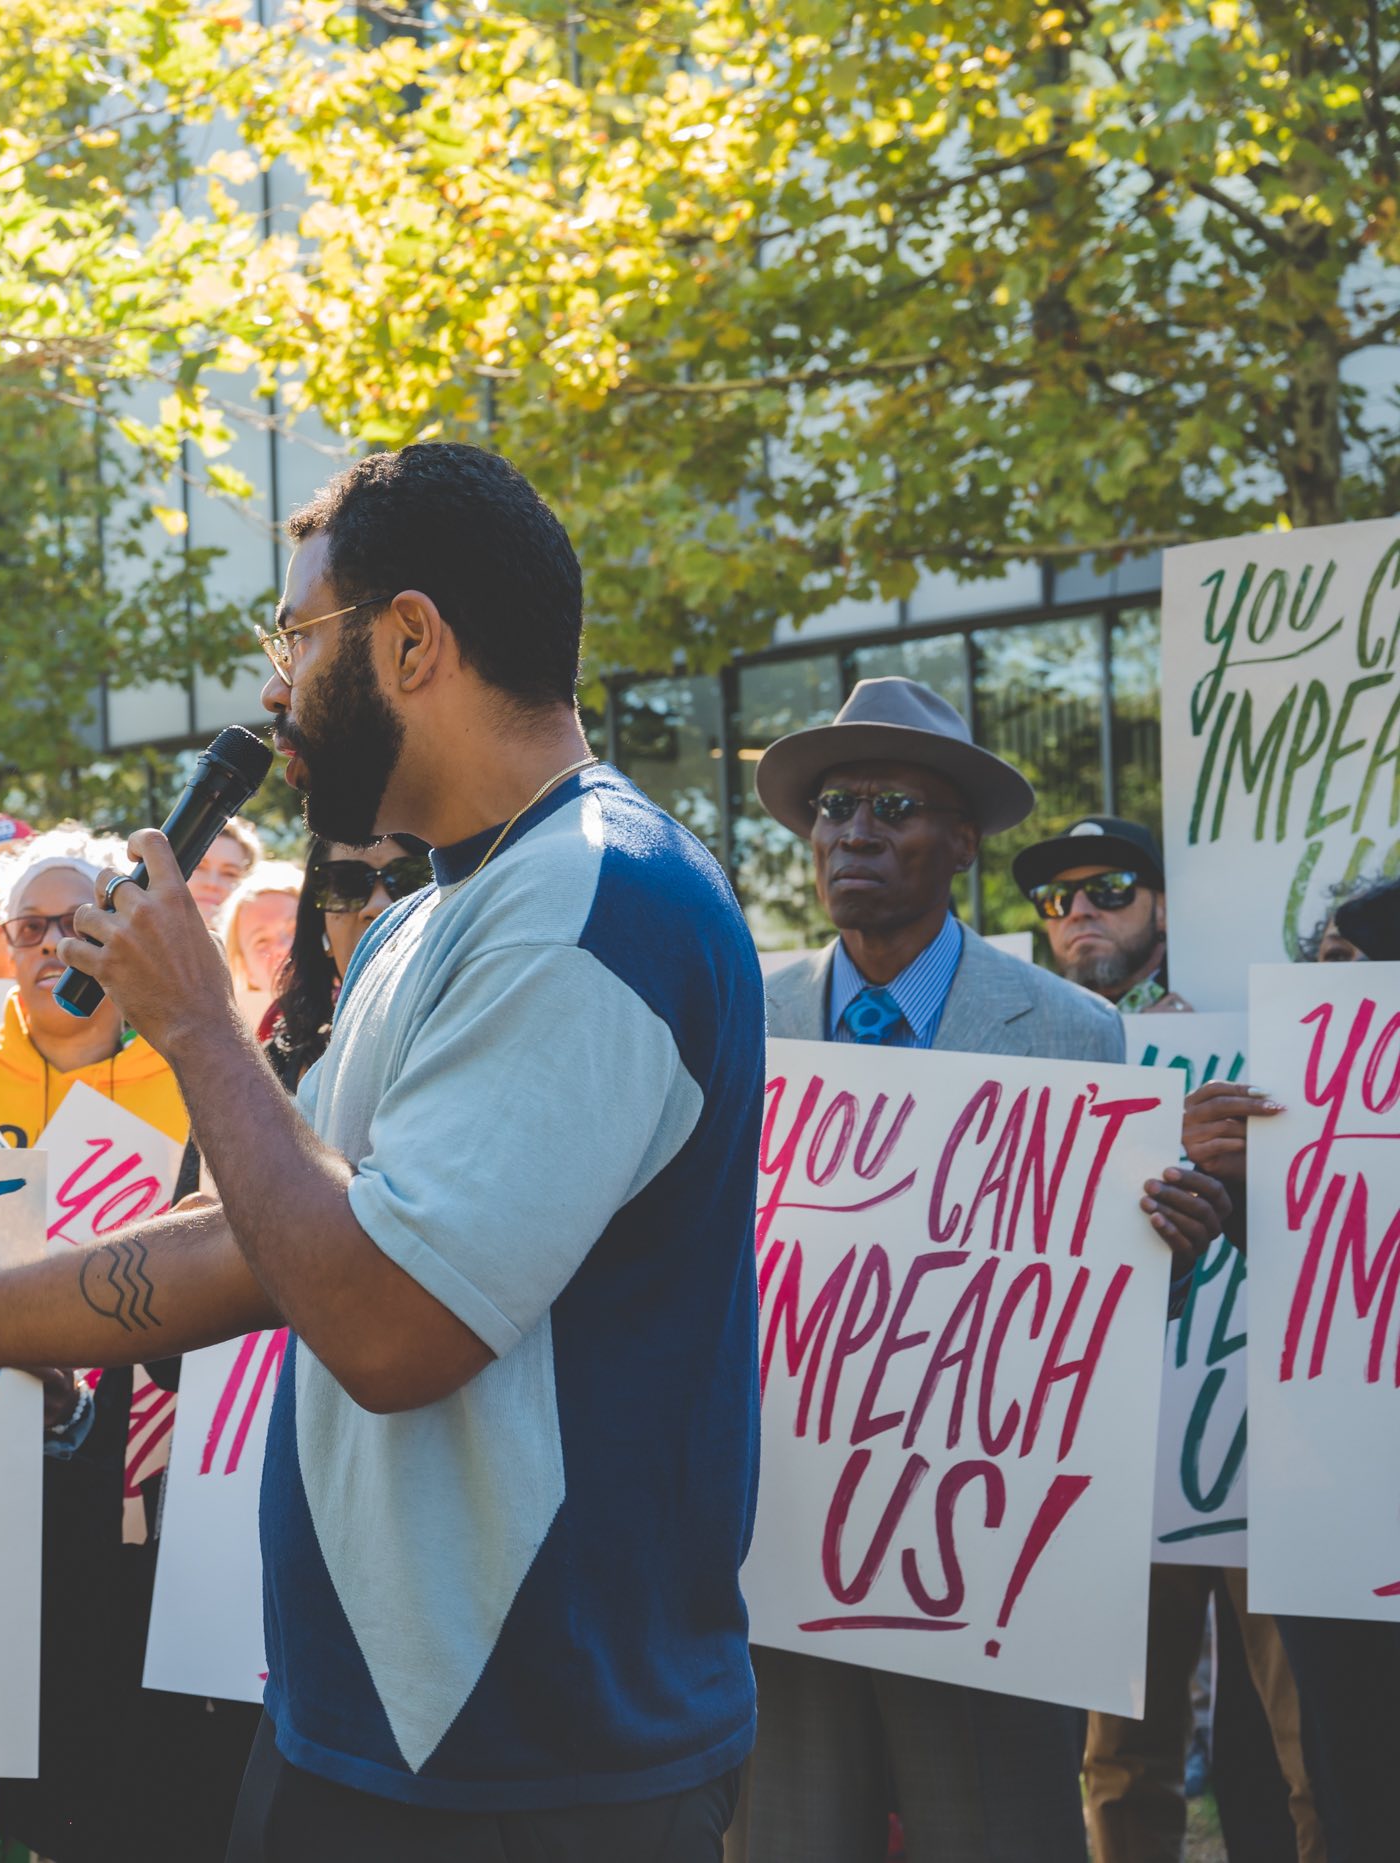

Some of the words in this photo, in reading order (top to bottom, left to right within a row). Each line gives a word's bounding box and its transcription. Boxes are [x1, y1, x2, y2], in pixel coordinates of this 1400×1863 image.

[1190, 560, 1344, 737] YOU
[928, 1080, 1162, 1258] CAN'T
[820, 1448, 1092, 1659] US!
